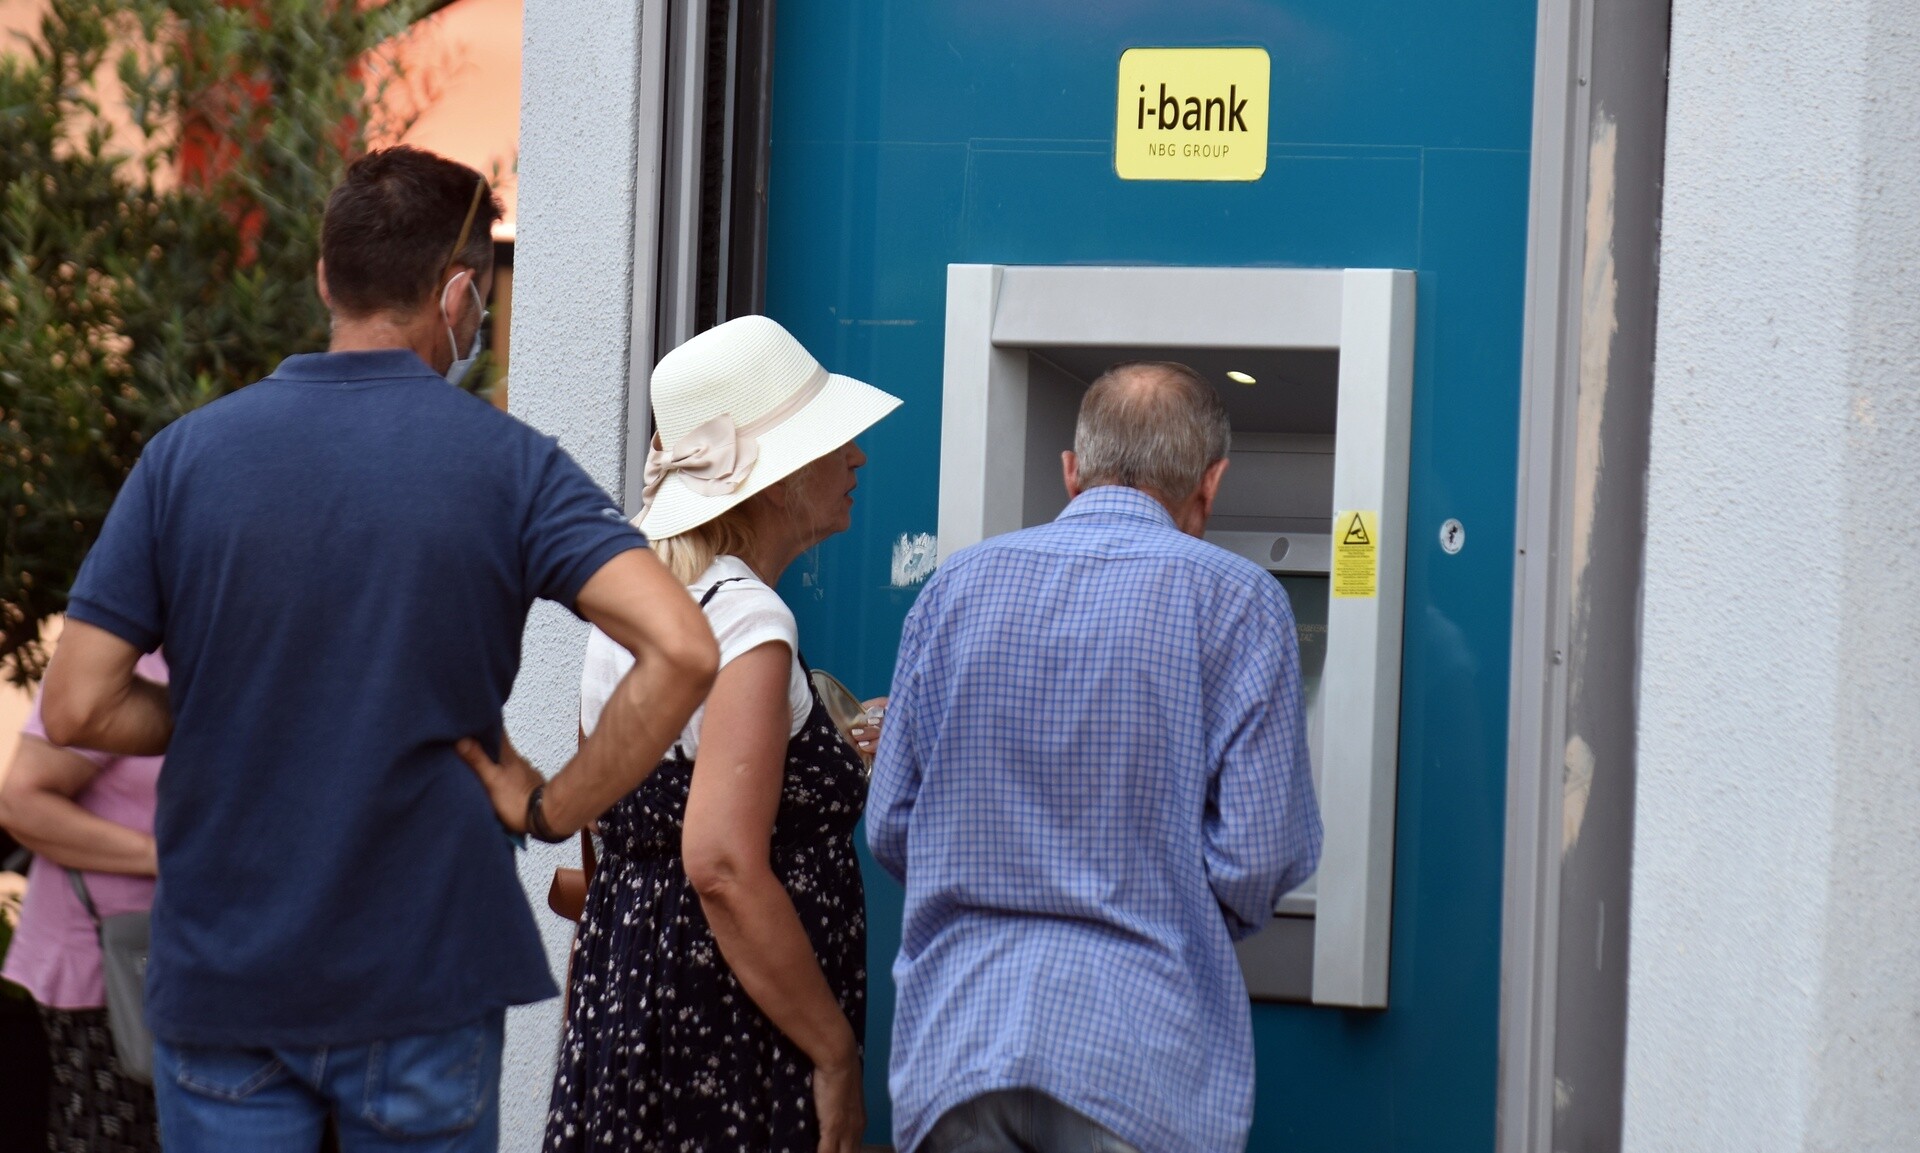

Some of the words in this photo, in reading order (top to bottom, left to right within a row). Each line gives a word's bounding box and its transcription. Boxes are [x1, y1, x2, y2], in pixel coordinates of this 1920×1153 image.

[1137, 82, 1249, 132] i-bank
[1149, 143, 1176, 157] NBG
[1183, 144, 1230, 158] GROUP
